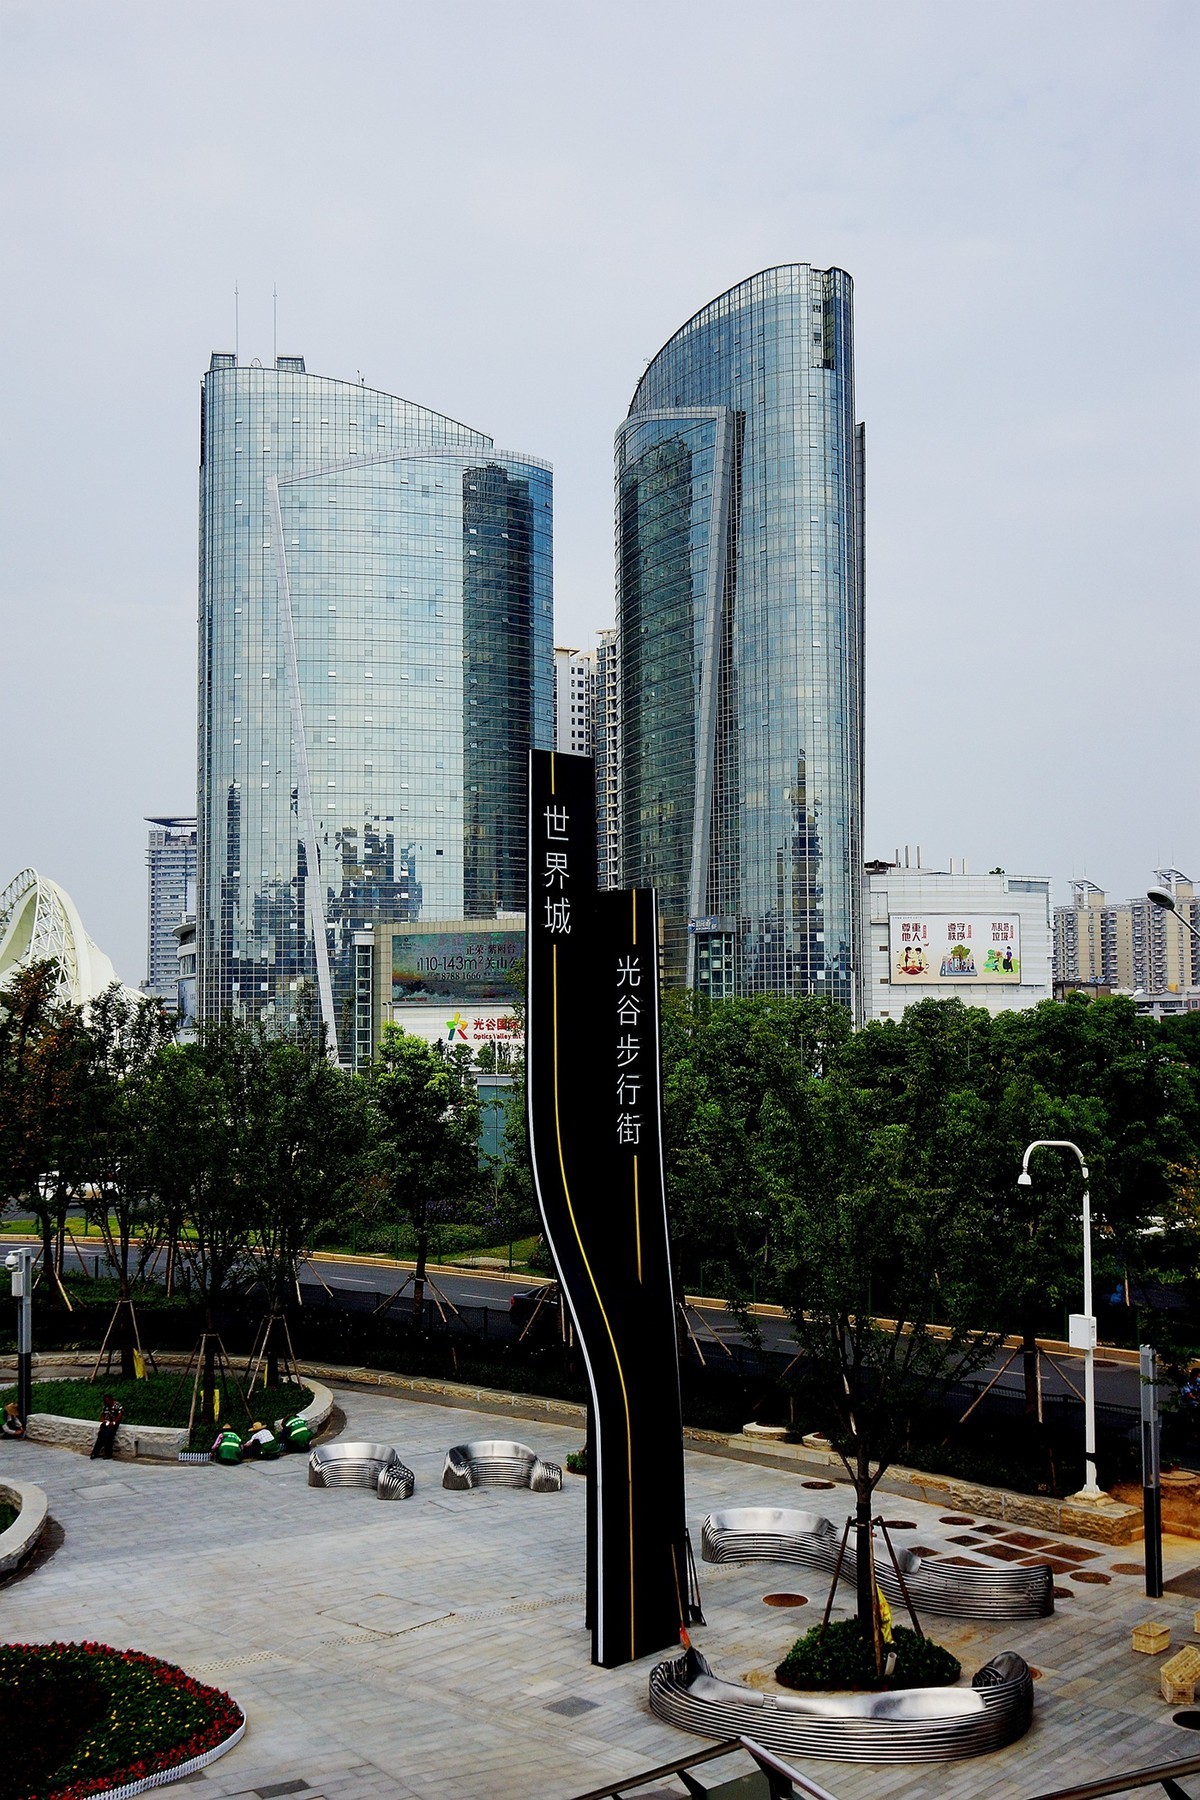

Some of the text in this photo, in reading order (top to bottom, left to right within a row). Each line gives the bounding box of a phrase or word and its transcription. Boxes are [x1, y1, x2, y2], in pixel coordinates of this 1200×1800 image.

[543, 804, 571, 935] 世界城
[901, 922, 921, 932] 尊重
[901, 932, 921, 941] 他人
[992, 932, 1009, 941] 垃圾
[441, 971, 460, 981] 8788
[462, 971, 481, 981] 1666
[473, 1033, 492, 1041] Optics
[492, 1033, 511, 1041] Valley
[616, 955, 641, 1145] 光谷步行街
